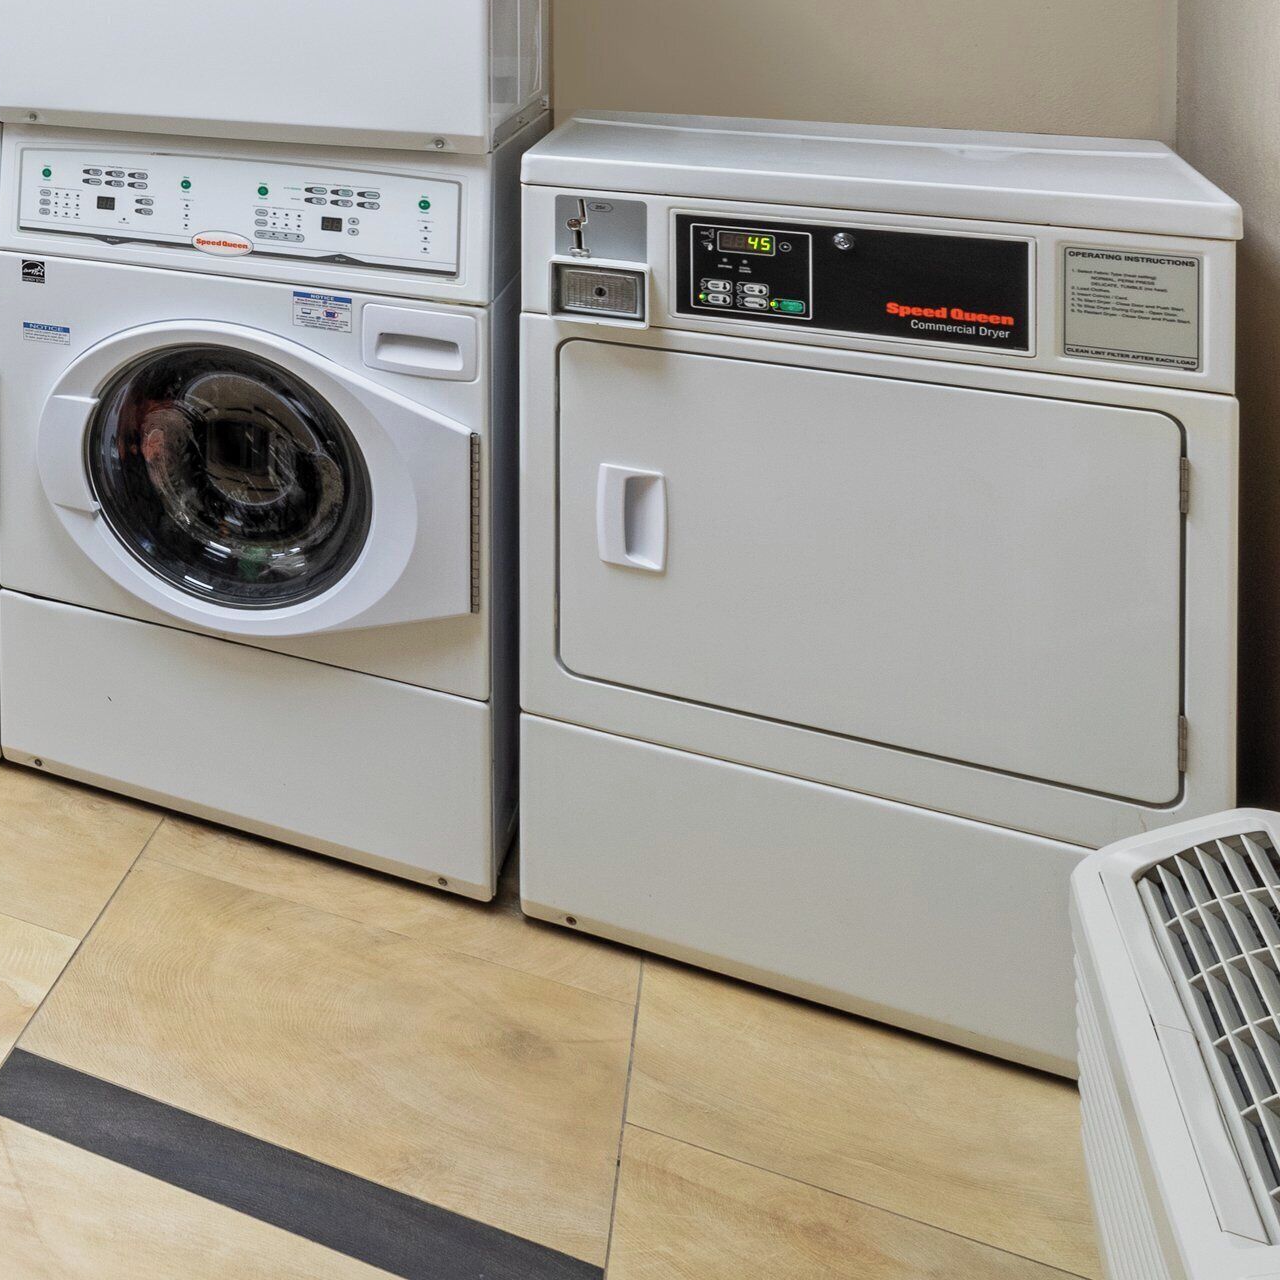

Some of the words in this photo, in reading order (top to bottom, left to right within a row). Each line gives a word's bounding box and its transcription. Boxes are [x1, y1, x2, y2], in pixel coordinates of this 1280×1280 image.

[196, 238, 221, 246] Speed
[222, 241, 248, 250] Queen
[748, 236, 771, 251] 45
[1068, 250, 1122, 261] OPERATING
[1124, 255, 1196, 268] INSTRUCTIONS
[310, 293, 335, 302] NOTICE
[886, 301, 948, 319] Speed
[950, 308, 1015, 326] Queen
[29, 323, 65, 333] NOTICE
[910, 319, 976, 335] Commercial
[978, 326, 1011, 339] Dryer
